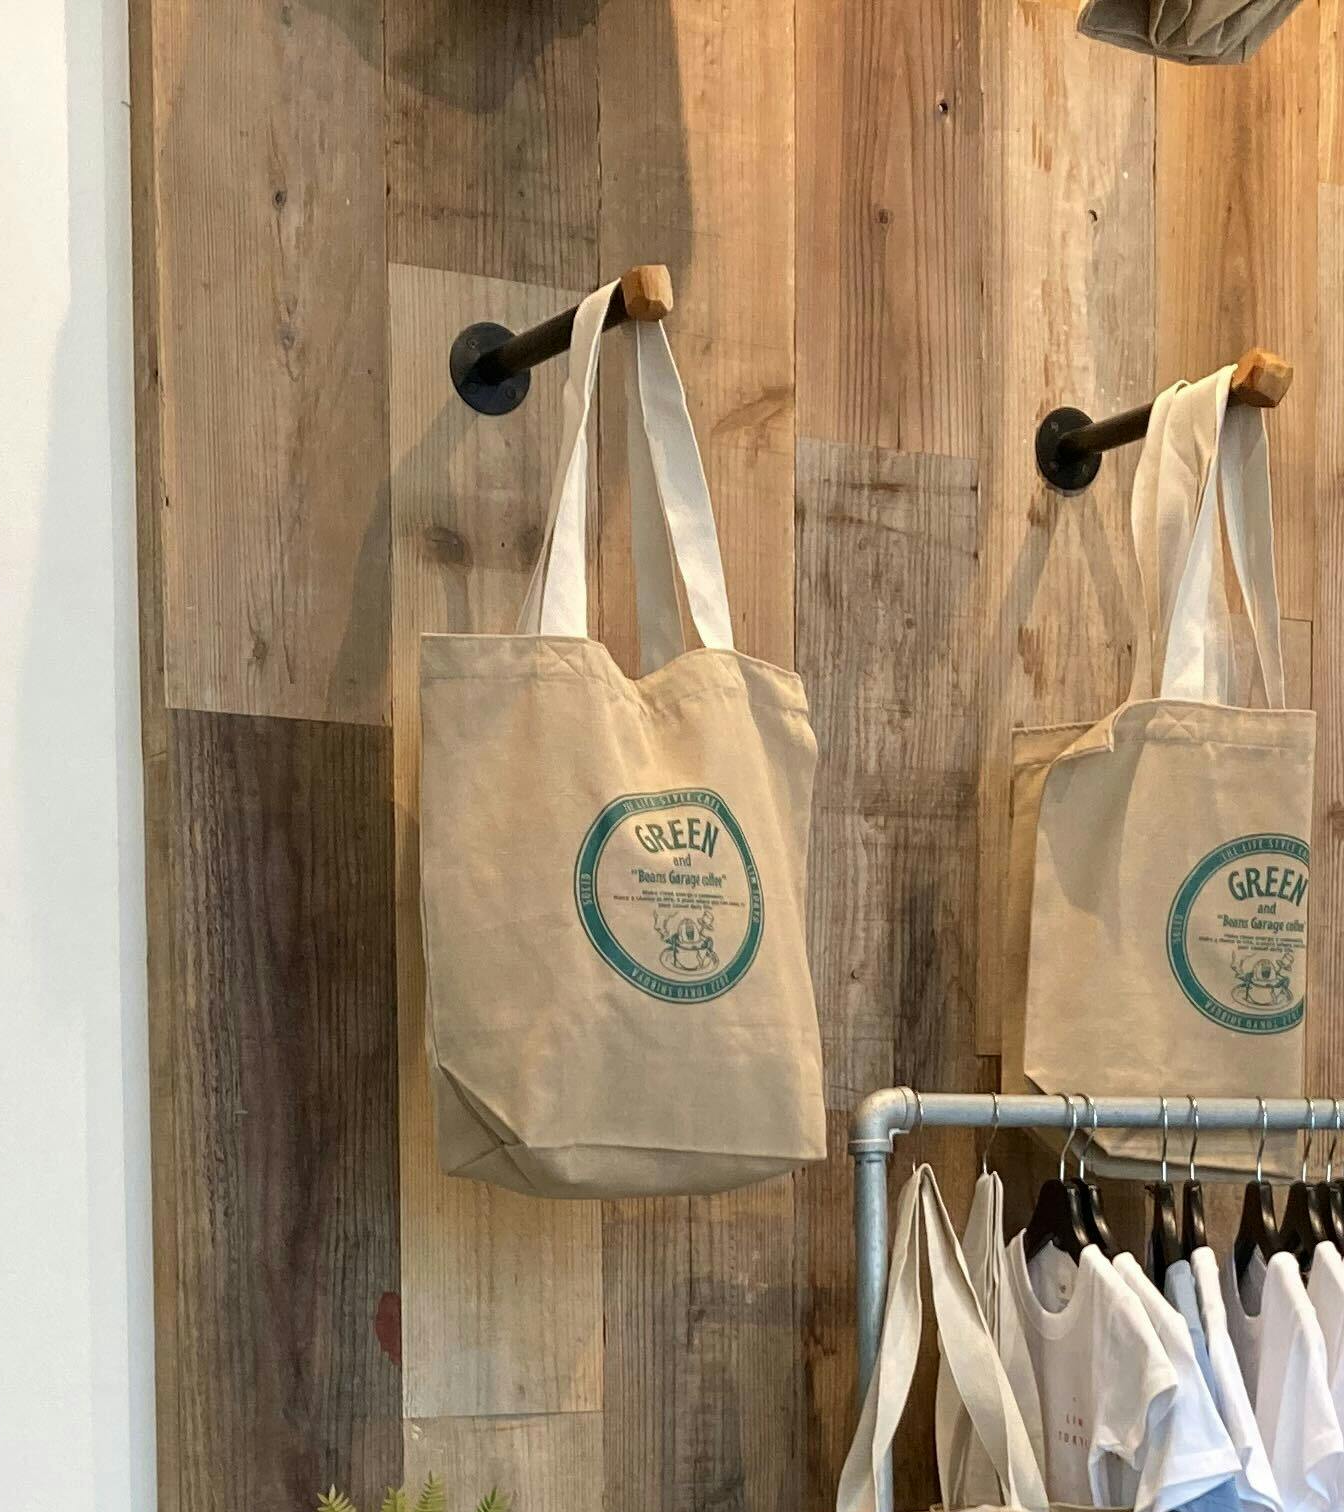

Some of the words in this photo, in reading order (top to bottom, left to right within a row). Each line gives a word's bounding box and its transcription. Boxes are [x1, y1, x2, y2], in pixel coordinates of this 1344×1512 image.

[635, 817, 719, 858] GREEN
[673, 853, 692, 866] and
[669, 869, 699, 888] Garage
[1228, 865, 1309, 907] GREEN
[1257, 902, 1276, 914] and
[1251, 916, 1284, 933] Garage
